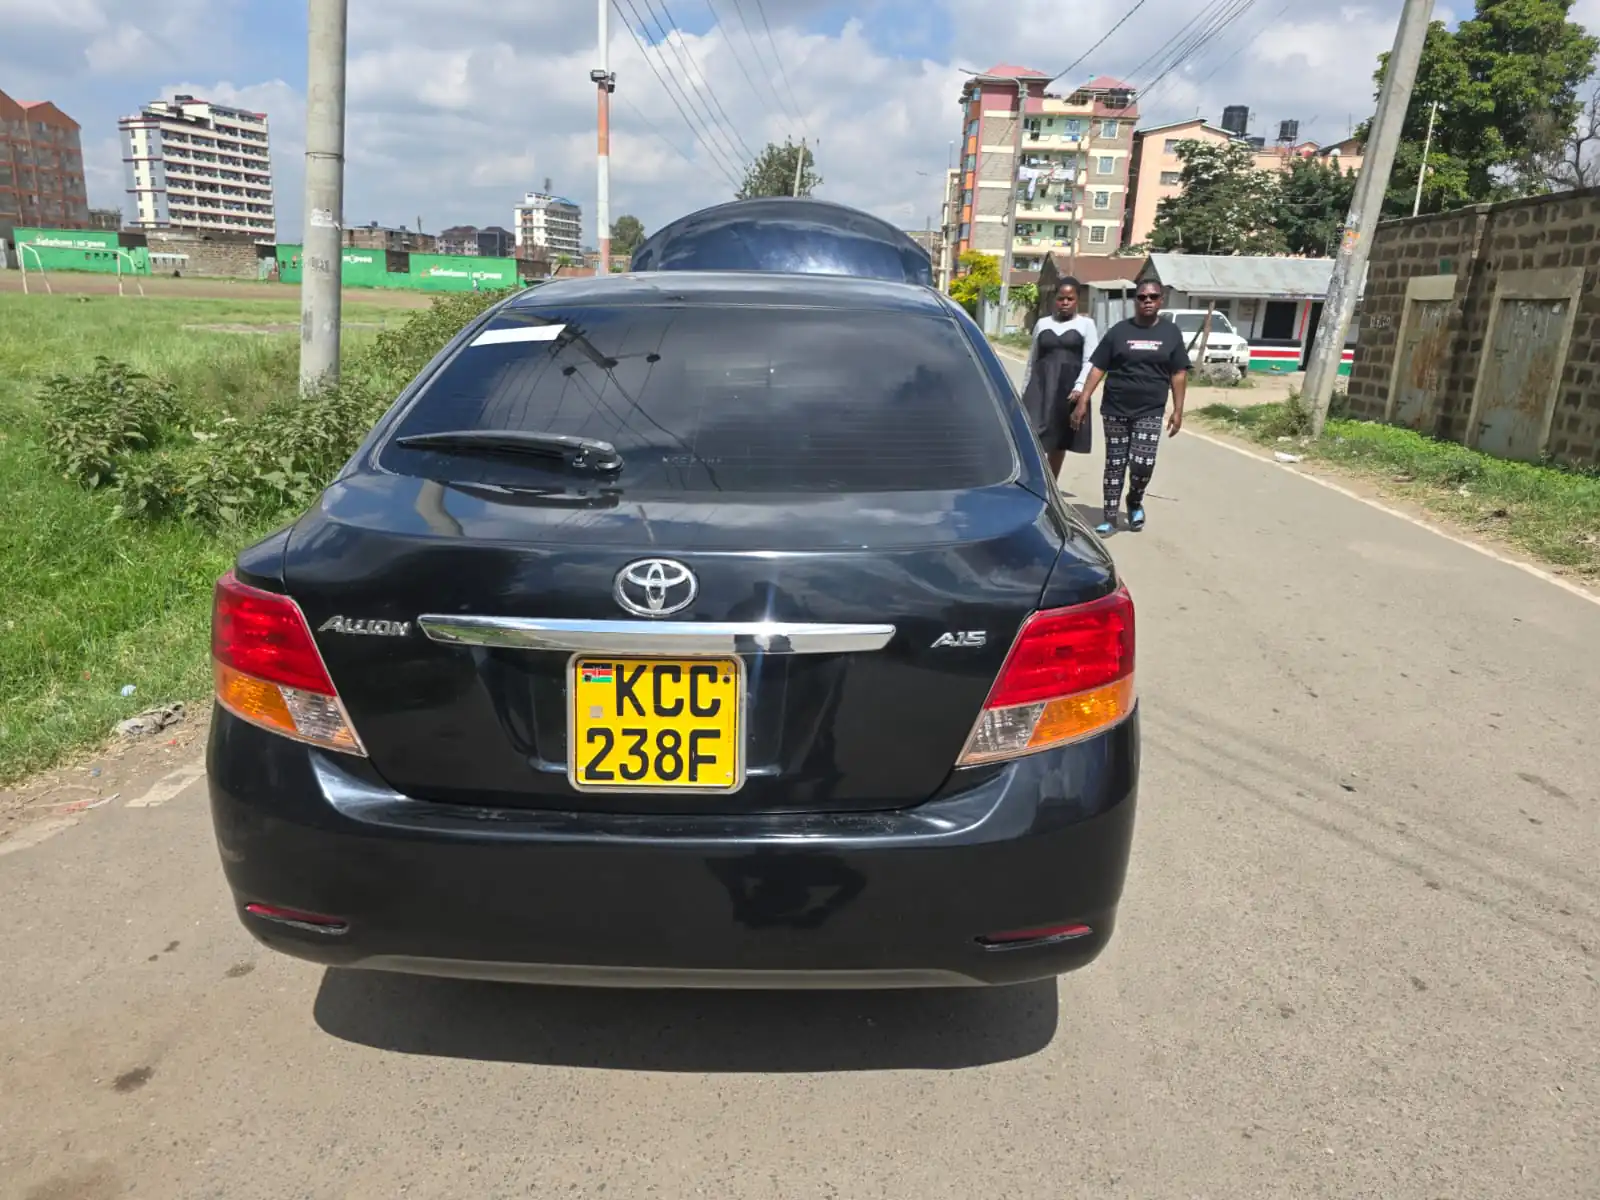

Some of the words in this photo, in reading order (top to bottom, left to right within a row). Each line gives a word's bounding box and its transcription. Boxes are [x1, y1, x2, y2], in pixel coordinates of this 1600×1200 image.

[318, 615, 411, 636] ALLION
[930, 630, 986, 648] A15
[615, 664, 721, 717] KCC
[585, 728, 721, 782] 238F
